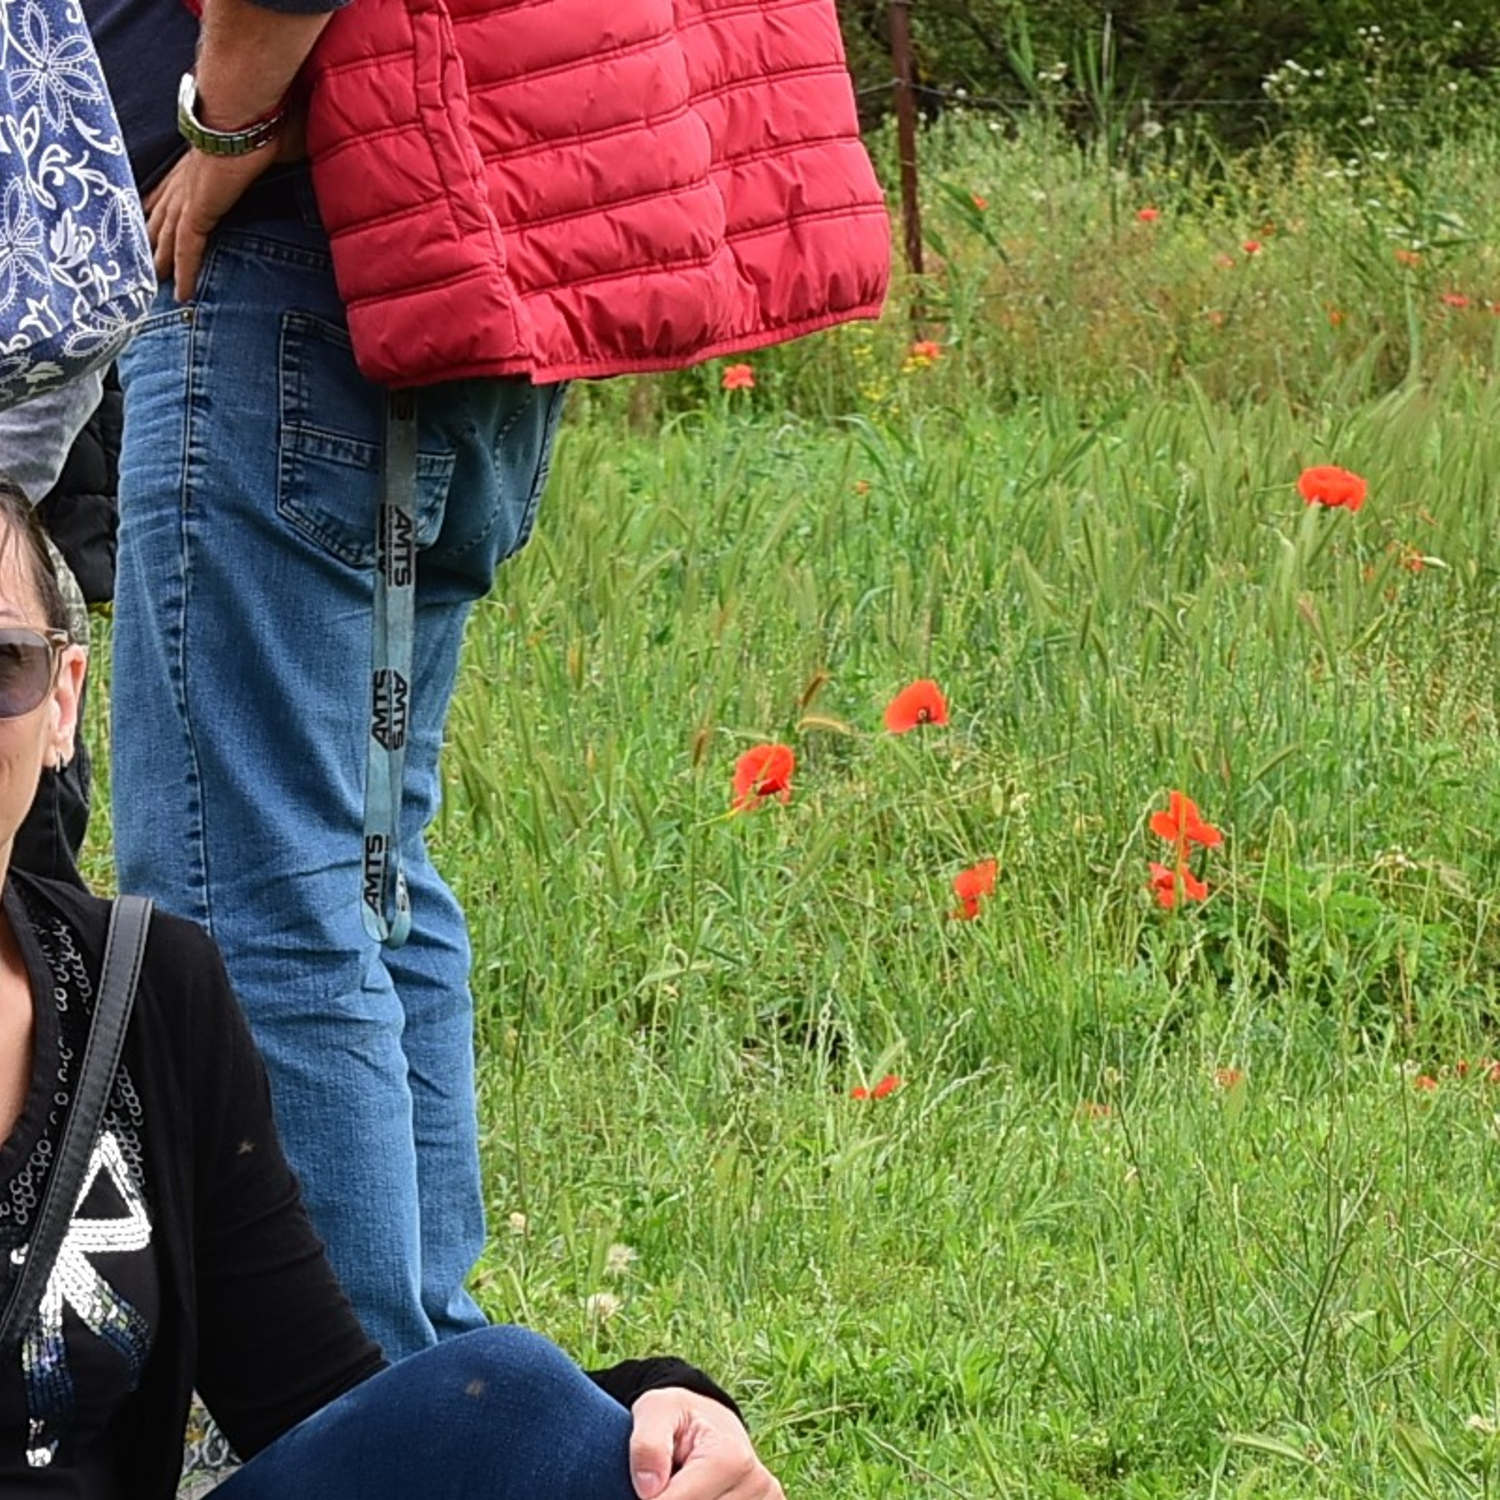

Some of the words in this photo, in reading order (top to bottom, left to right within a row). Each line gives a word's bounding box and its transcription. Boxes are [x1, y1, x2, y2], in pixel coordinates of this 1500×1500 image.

[394, 506, 412, 587] AMTS
[372, 669, 389, 751] AMTS
[393, 670, 408, 750] AMTS
[364, 834, 382, 917] AMTS
